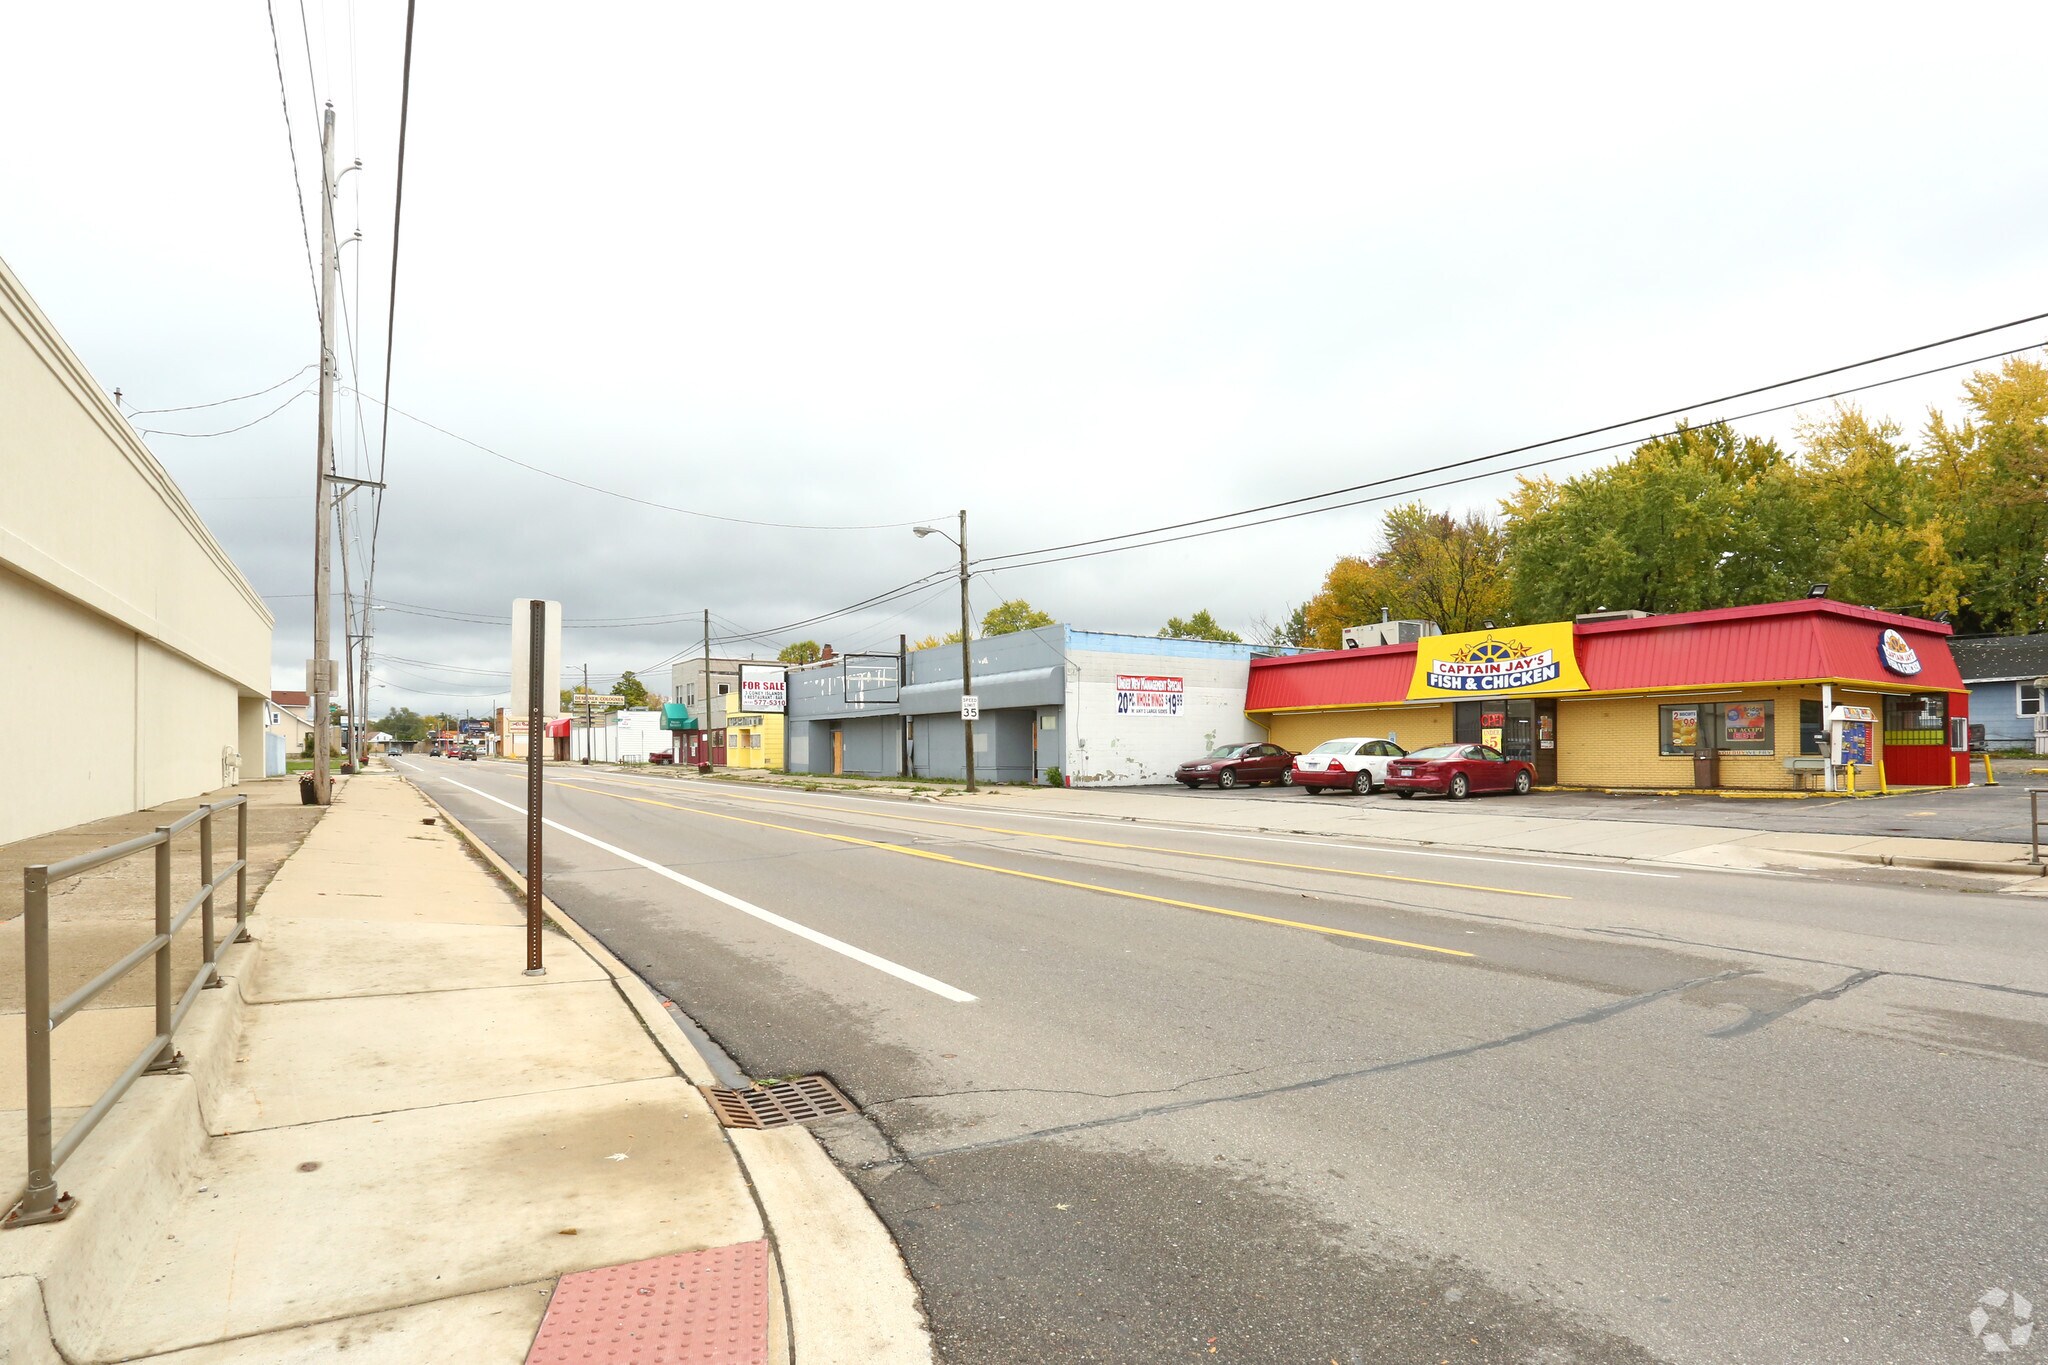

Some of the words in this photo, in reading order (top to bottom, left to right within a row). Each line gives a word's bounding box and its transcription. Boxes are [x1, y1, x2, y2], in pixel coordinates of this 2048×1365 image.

[1439, 663, 1501, 675] CAPTAIN
[1505, 655, 1544, 672] JAY'S
[1430, 673, 1462, 690] FISH
[1465, 677, 1478, 690] &
[1481, 664, 1555, 690] CHICKEN
[743, 681, 760, 690] FOR
[763, 681, 785, 690] SALE
[1118, 692, 1128, 713] 20
[1136, 693, 1150, 706] WHOLE
[963, 708, 977, 717] 35
[1673, 711, 1679, 720] 2
